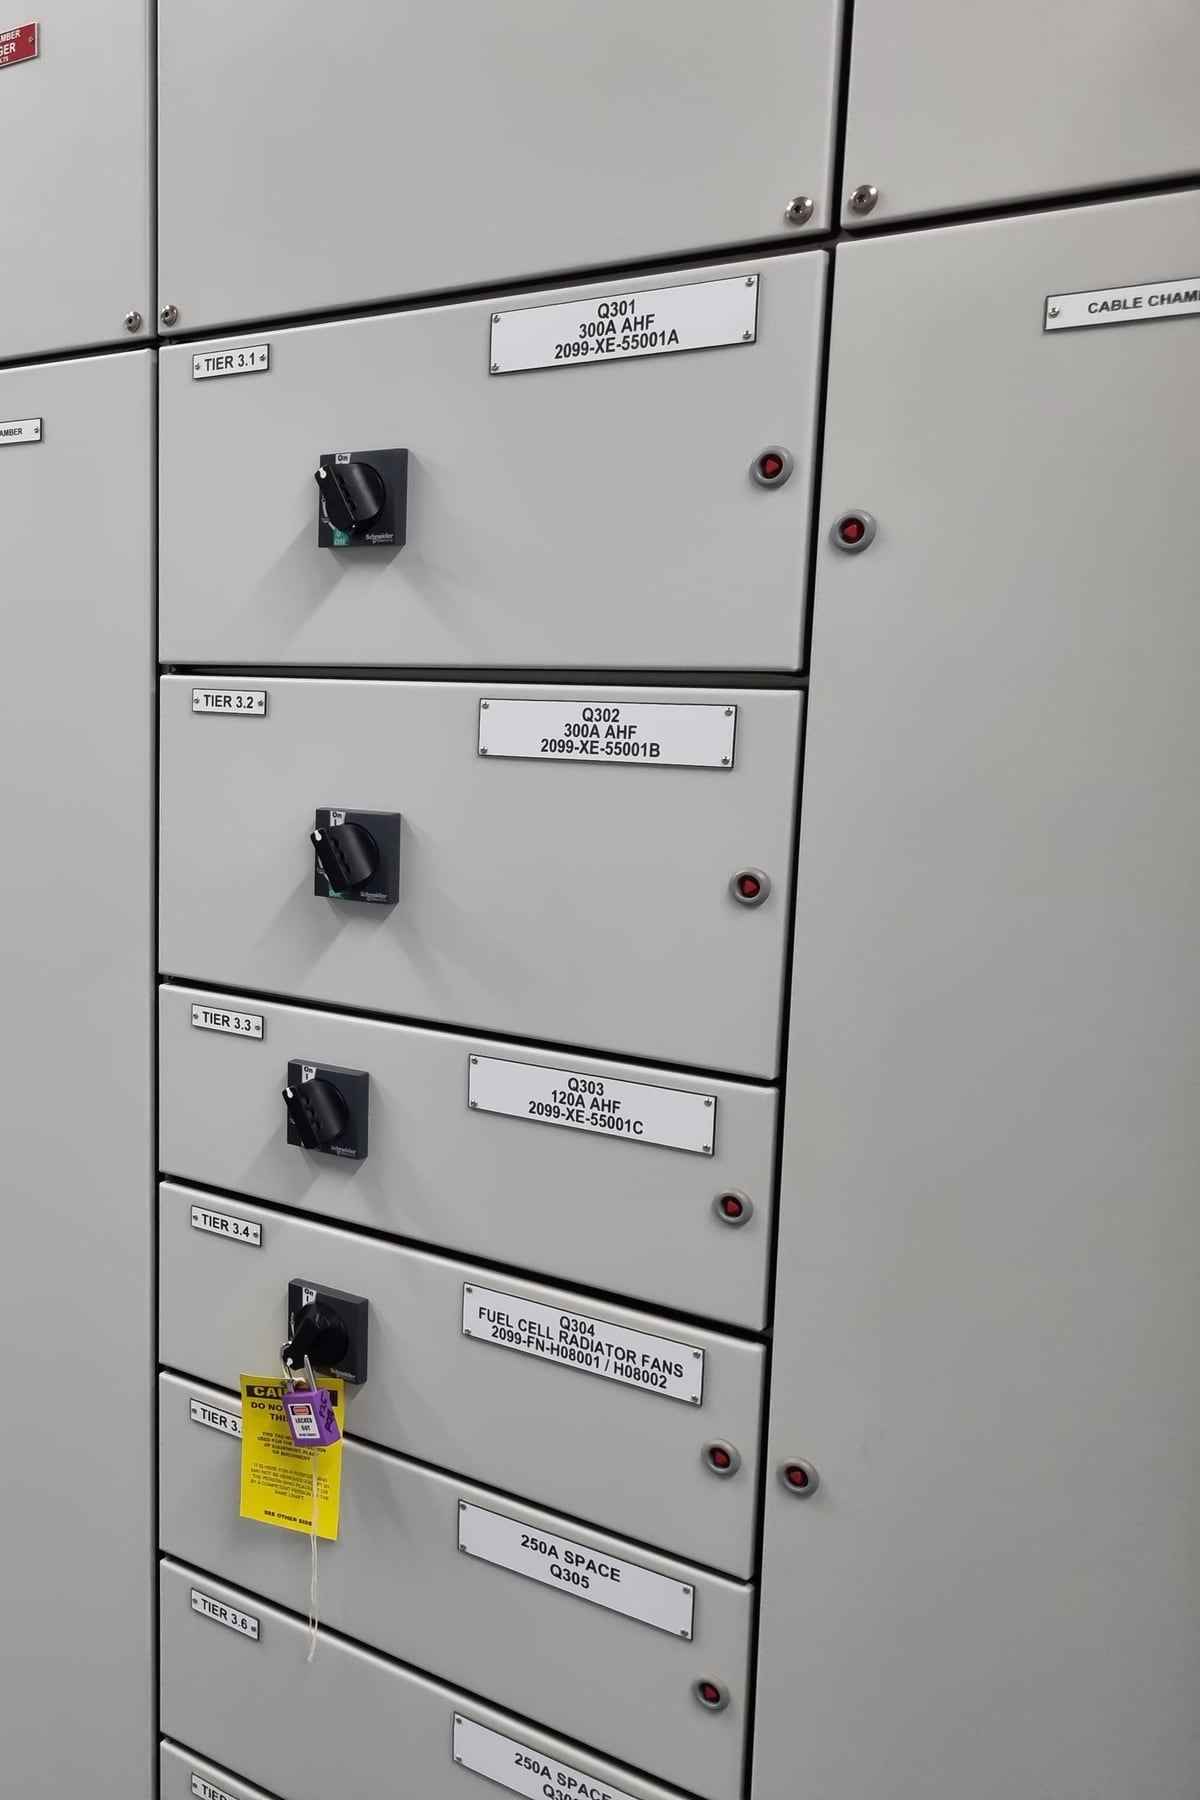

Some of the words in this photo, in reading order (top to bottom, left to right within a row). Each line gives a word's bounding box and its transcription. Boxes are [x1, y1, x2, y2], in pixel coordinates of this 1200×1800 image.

[597, 300, 635, 318] Q301
[1088, 297, 1142, 314] CABLE
[1148, 290, 1200, 307] CHAM
[579, 320, 616, 338] 300A
[621, 314, 655, 332] AHF
[554, 330, 679, 359] 2099-XE-55001A
[205, 355, 233, 371] TIER
[238, 353, 254, 367] 3.1
[203, 694, 232, 708] TIER
[236, 696, 254, 709] 3.2
[582, 707, 620, 723] Q302
[564, 723, 600, 738] 300A
[604, 724, 637, 739] AHF
[541, 739, 660, 758] 2099-XE-55001B
[202, 1011, 230, 1027] TIER
[234, 1017, 251, 1031] 3.3
[568, 1077, 604, 1096] Q303
[552, 1090, 586, 1108] 120A
[589, 1098, 621, 1114] AHF
[528, 1101, 643, 1135] 2099-XE-55001C
[201, 1213, 229, 1232] TIER
[233, 1223, 250, 1237] 3.4
[560, 1316, 595, 1337] Q304
[479, 1307, 514, 1331] FUEL
[518, 1318, 554, 1340] CELL
[557, 1330, 636, 1365] RADIATOR
[642, 1354, 683, 1378] FANS
[491, 1325, 599, 1368] 2099-FN-H08001
[604, 1359, 610, 1372] /
[614, 1363, 667, 1389] H08002
[251, 1402, 265, 1410] DO
[268, 1404, 284, 1412] NO
[200, 1408, 227, 1427] TIER
[231, 1420, 241, 1433] 3.
[277, 1512, 297, 1522] OTHER
[299, 1518, 312, 1527] SIDE
[521, 1535, 559, 1559] 250A
[564, 1550, 620, 1583] SPACE
[550, 1564, 589, 1589] Q305
[201, 1598, 227, 1621] TIER
[231, 1613, 248, 1629] 3.6
[514, 1753, 552, 1780] 250A
[557, 1772, 612, 1800] SPACE
